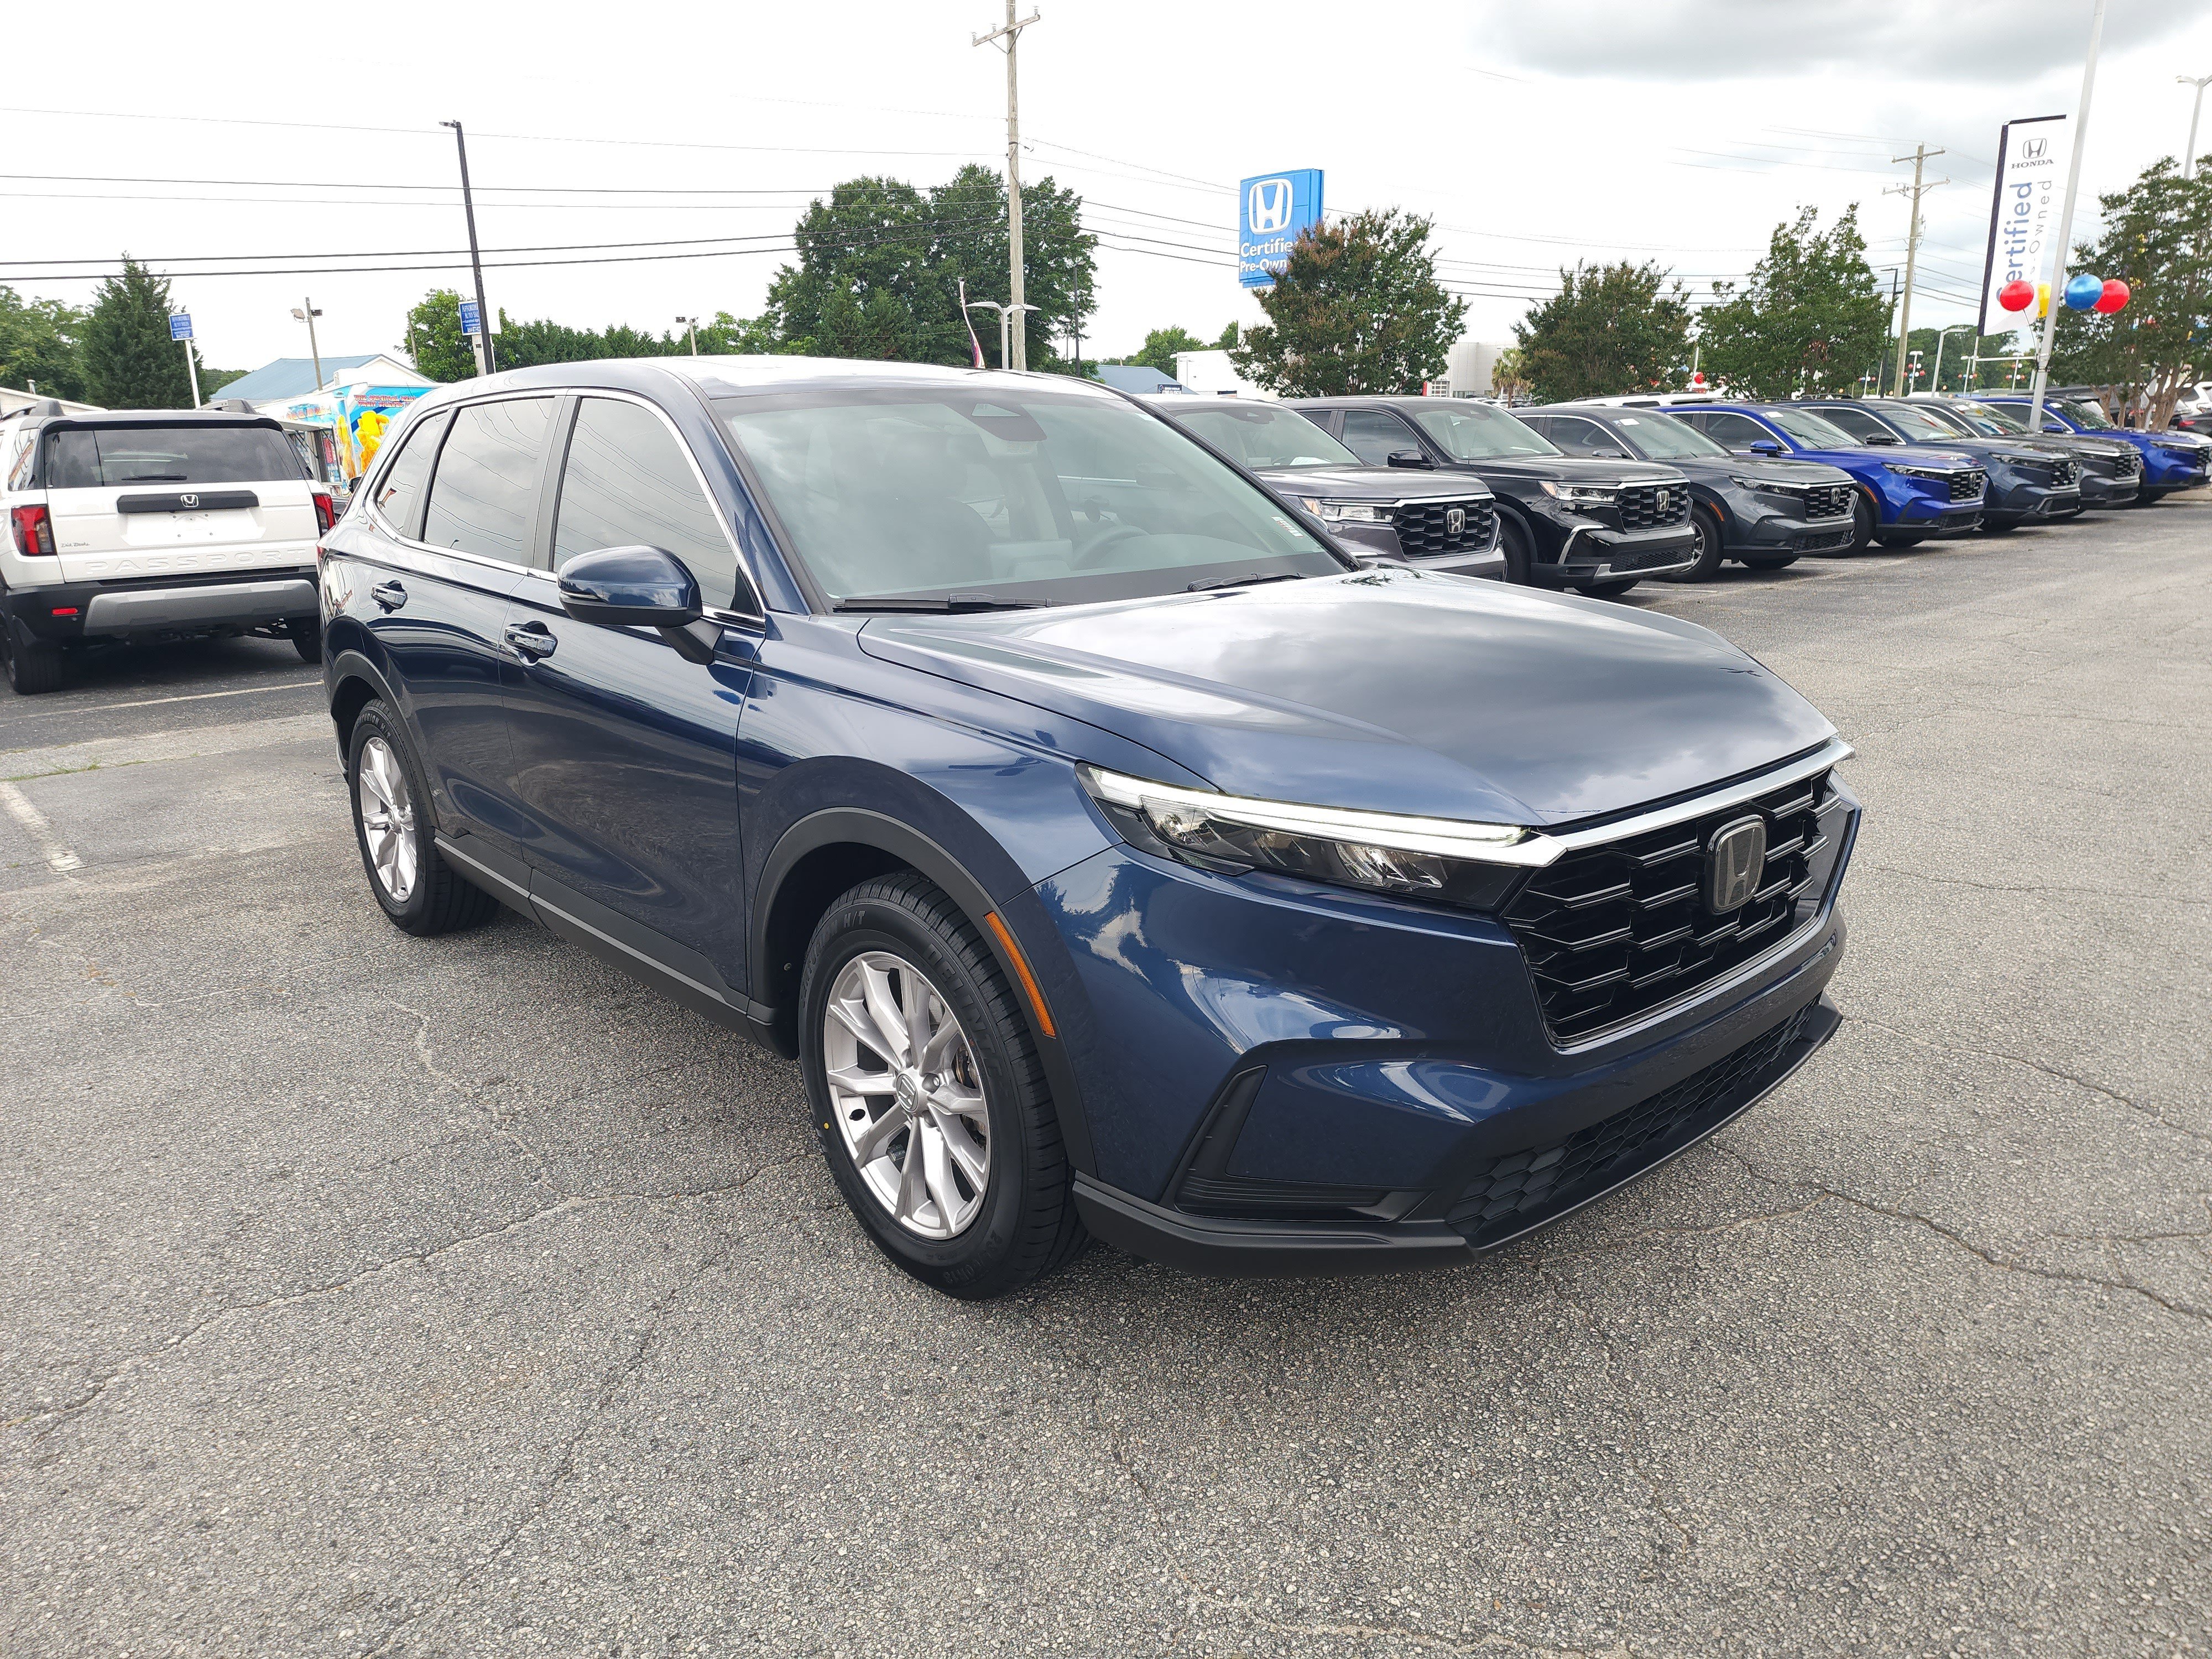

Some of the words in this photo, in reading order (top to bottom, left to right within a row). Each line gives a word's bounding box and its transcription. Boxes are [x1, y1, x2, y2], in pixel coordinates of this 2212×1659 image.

[2011, 159, 2054, 169] HONDA
[1240, 238, 1295, 258] Certifie
[1996, 182, 2032, 302] ertified
[1240, 258, 1287, 273] Pre-Own
[85, 549, 306, 575] PASSPORT
[843, 910, 865, 928] H/T
